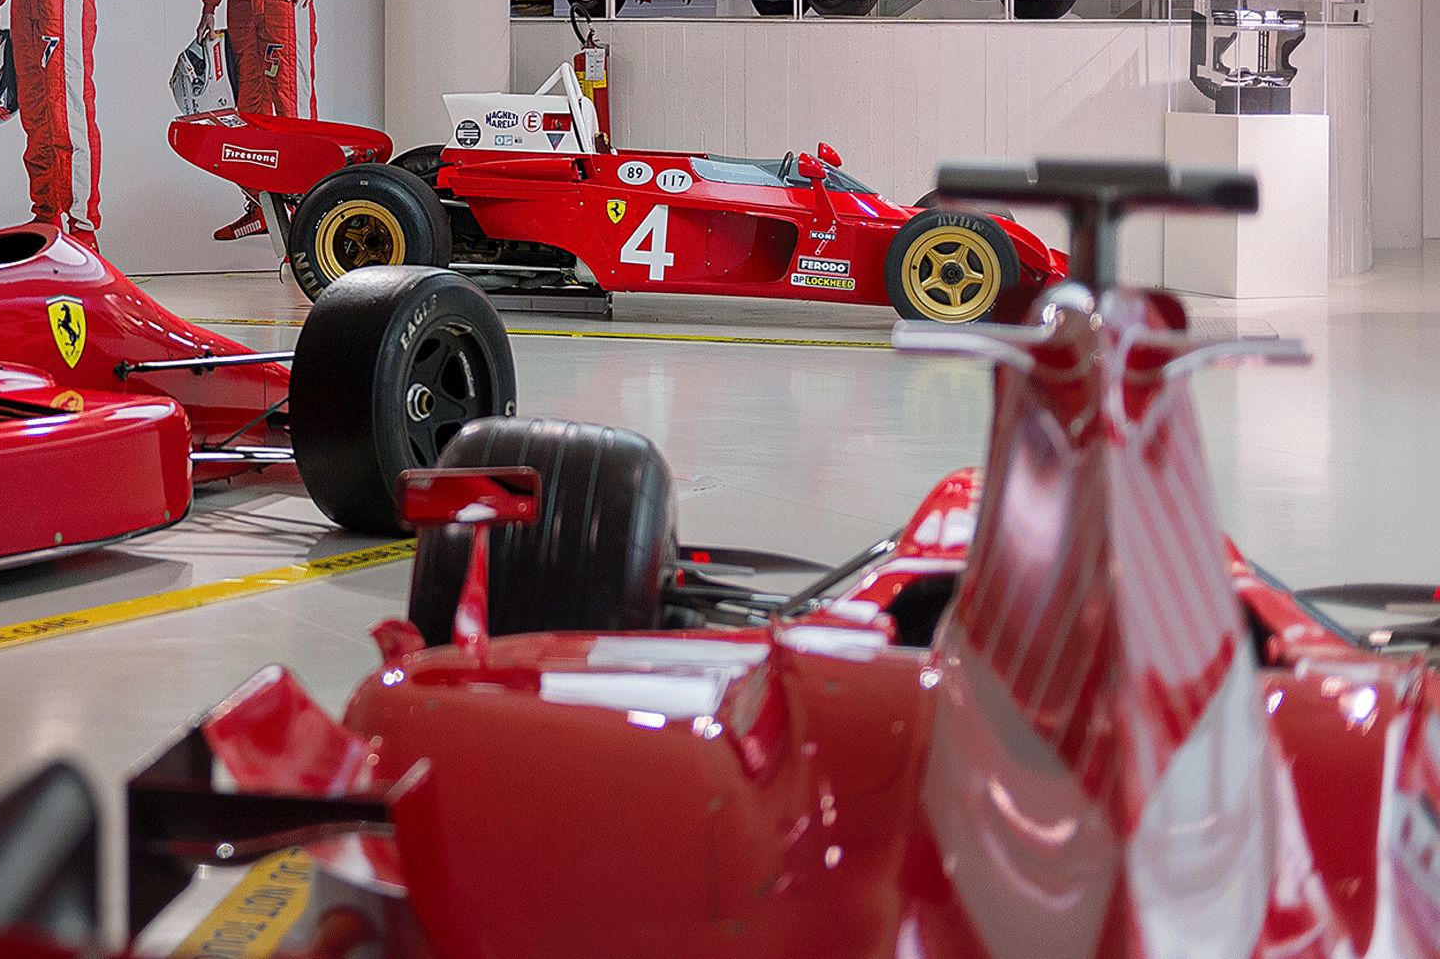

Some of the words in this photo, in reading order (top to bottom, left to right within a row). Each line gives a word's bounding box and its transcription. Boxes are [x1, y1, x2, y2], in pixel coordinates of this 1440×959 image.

[41, 34, 60, 68] 7
[264, 43, 285, 78] 5
[225, 148, 276, 163] Firestone
[626, 166, 644, 179] 89
[662, 174, 686, 187] 117
[620, 204, 675, 281] 4
[811, 232, 836, 240] KONI
[800, 259, 847, 273] FERODO
[805, 275, 854, 289] LOCKHEED
[12, 616, 90, 636] CARS
